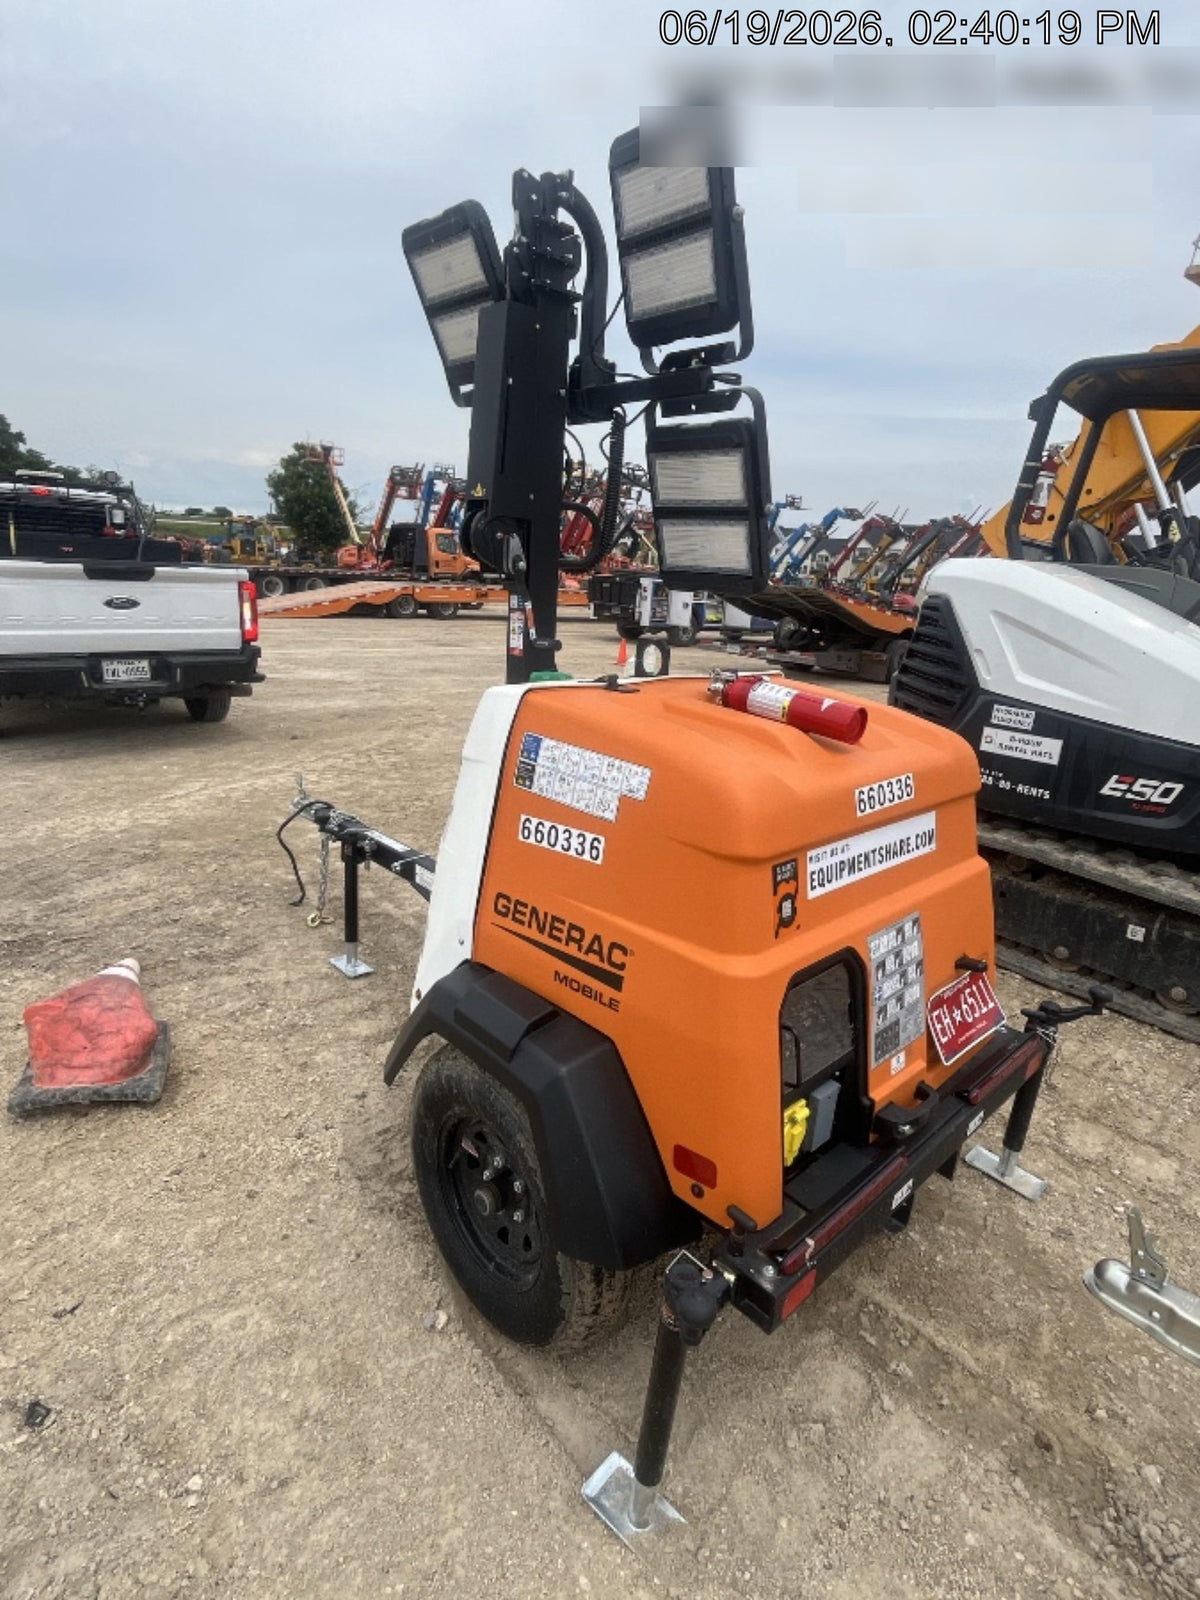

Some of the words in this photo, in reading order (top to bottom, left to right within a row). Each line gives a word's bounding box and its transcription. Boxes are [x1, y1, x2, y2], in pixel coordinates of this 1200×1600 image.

[857, 774, 914, 814] 660336
[1099, 774, 1185, 805] E50
[520, 817, 602, 862] 660336
[809, 827, 935, 892] EQUIPMENTSHARE.COM
[493, 892, 629, 973] GENERAC
[553, 970, 621, 1013] MOBILE
